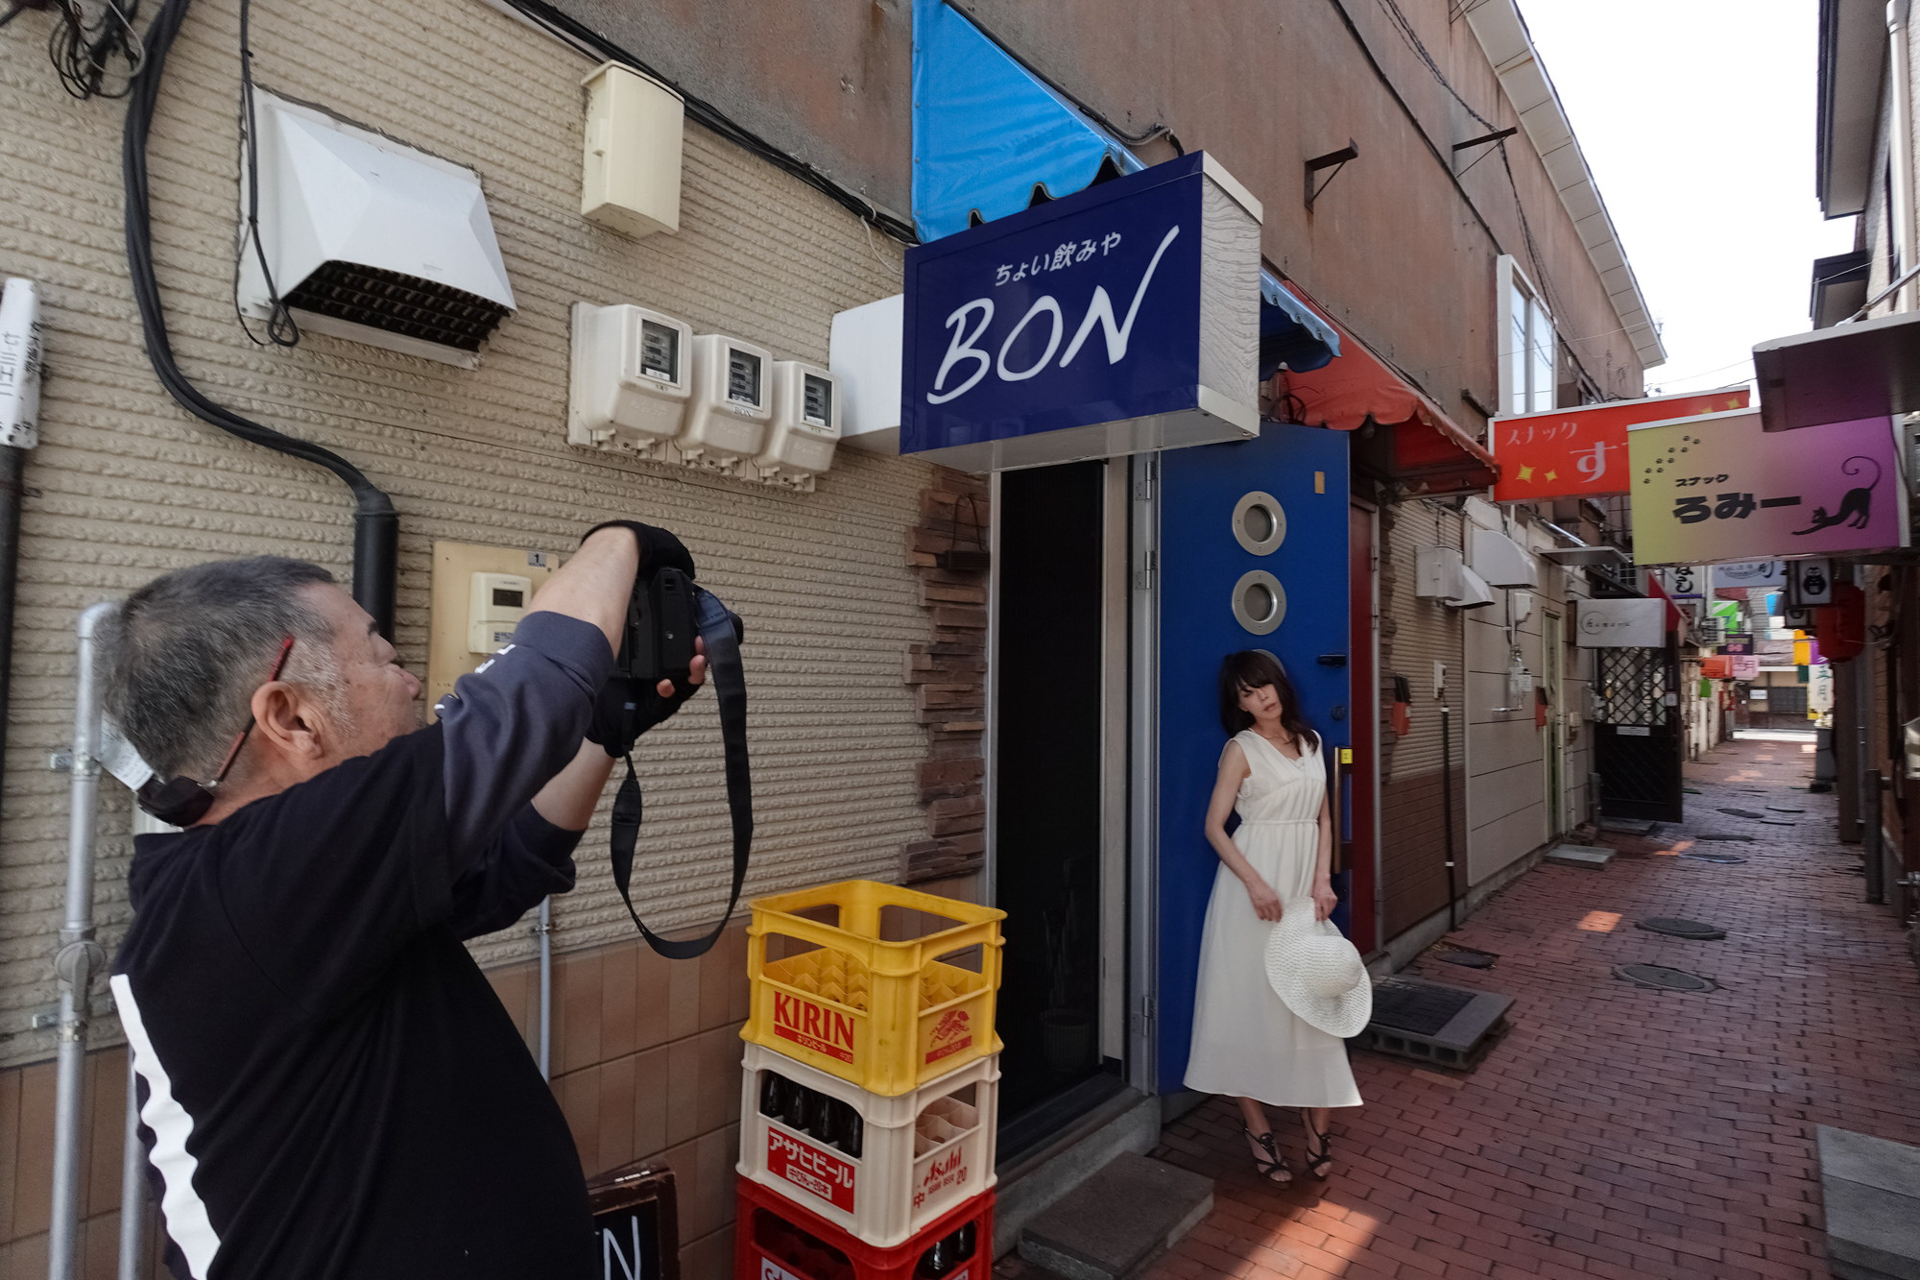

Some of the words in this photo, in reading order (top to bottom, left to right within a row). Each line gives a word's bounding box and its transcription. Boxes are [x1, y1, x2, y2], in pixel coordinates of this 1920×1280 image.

[995, 232, 1121, 286] ちょい飲みや
[927, 225, 1180, 405] BON
[1505, 422, 1577, 446] スナック
[1569, 441, 1628, 483] す
[1675, 473, 1729, 487] スナック
[1672, 492, 1802, 524] ろみー
[774, 991, 855, 1051] KIRIN
[769, 1131, 853, 1188] アサヒビール
[923, 1146, 962, 1187] Asahi
